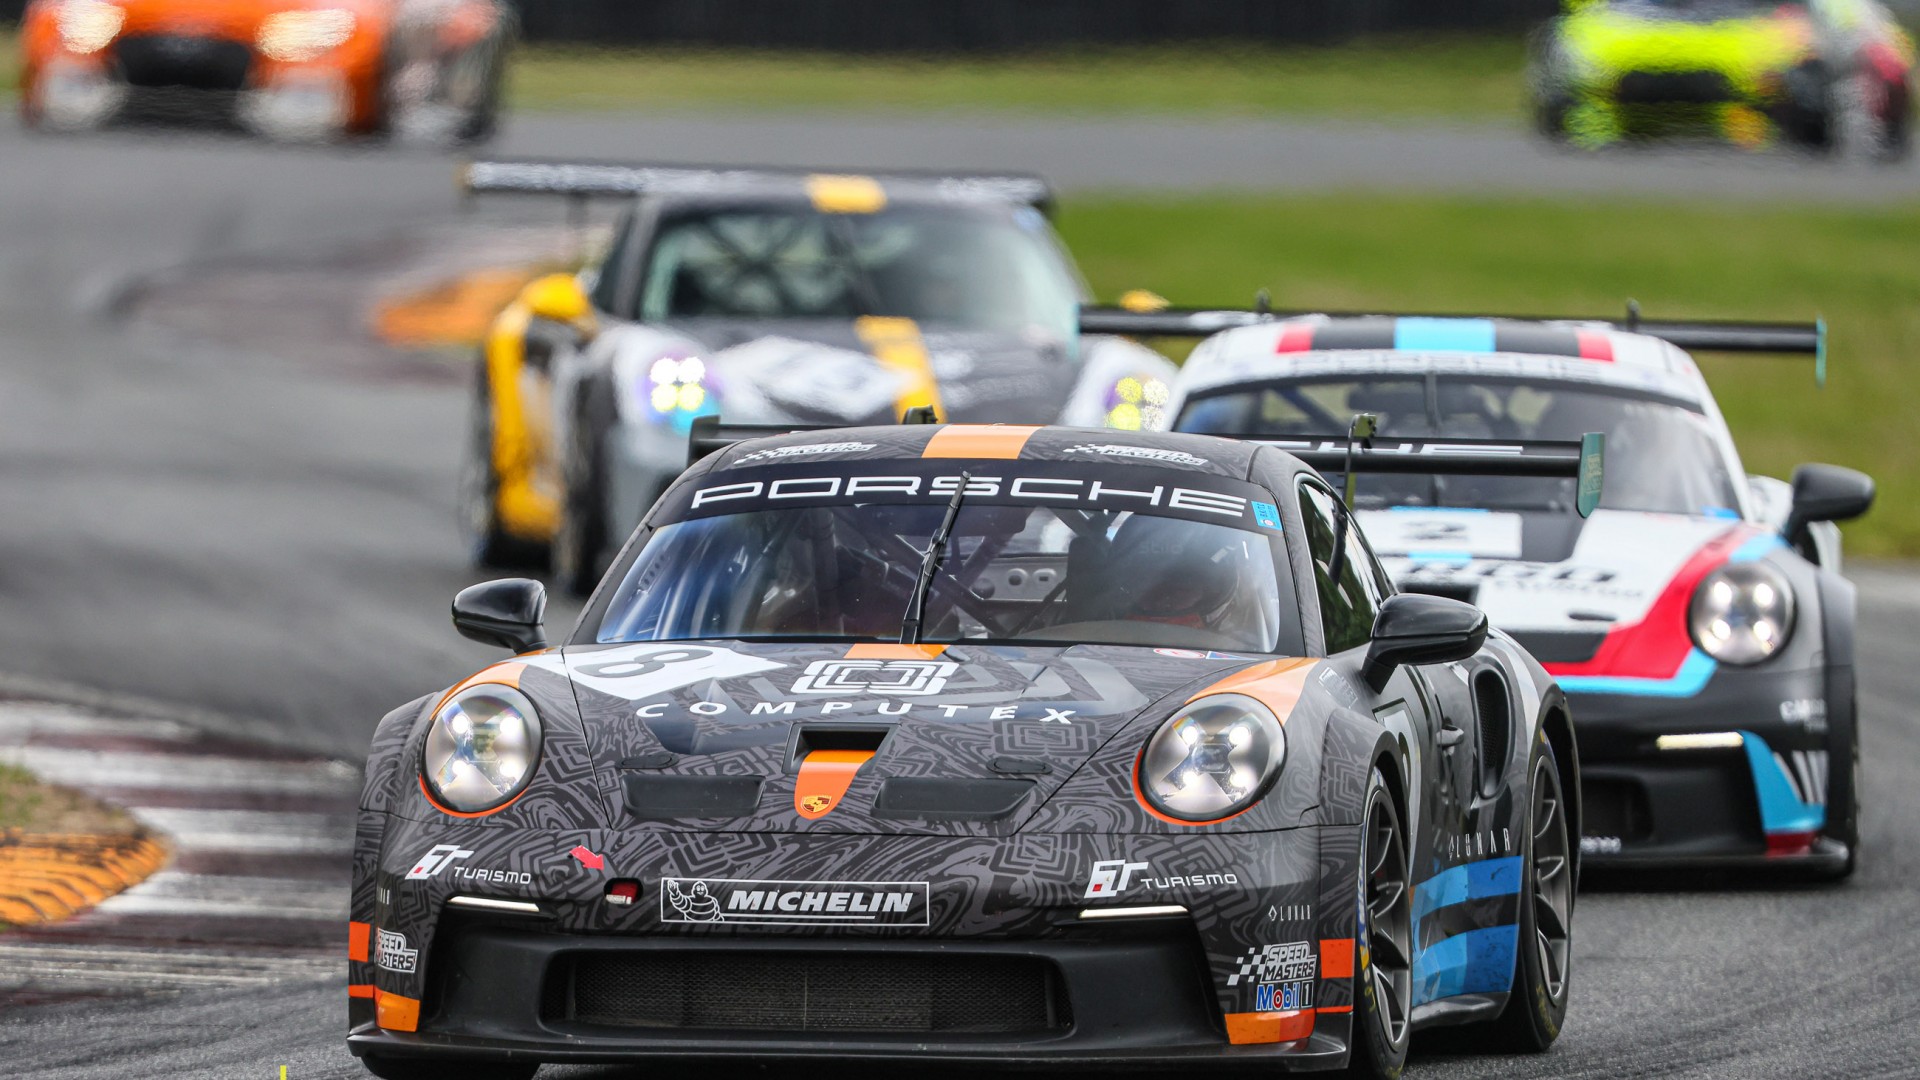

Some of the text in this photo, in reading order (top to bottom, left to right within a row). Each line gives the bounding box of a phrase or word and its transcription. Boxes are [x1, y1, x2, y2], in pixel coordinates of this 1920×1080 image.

[691, 476, 1246, 517] PORSCHE
[574, 649, 714, 678] 8
[636, 701, 1076, 724] COMPUTEX
[1456, 827, 1511, 858] LUNAR
[454, 866, 531, 885] TURISMO
[1140, 873, 1238, 890] TURISMO
[728, 890, 913, 913] MICHELIN
[1268, 944, 1310, 963] SPEED
[1262, 961, 1315, 981] MASTERS
[1256, 982, 1300, 1011] Mobil
